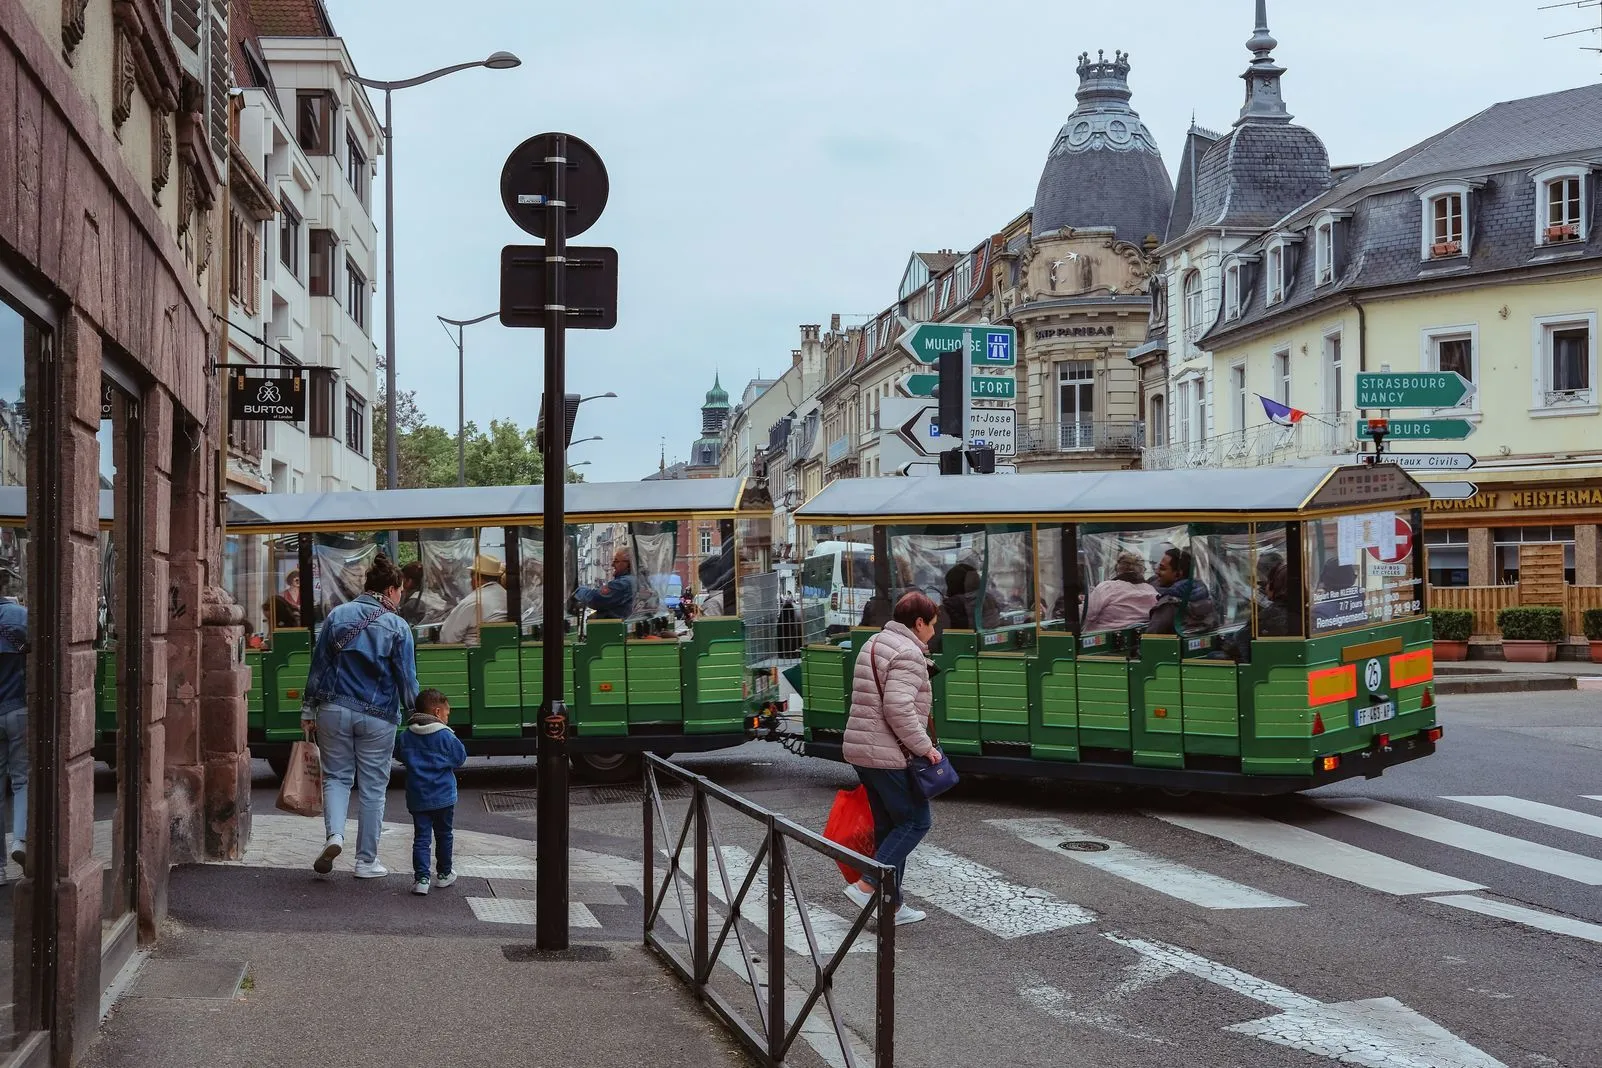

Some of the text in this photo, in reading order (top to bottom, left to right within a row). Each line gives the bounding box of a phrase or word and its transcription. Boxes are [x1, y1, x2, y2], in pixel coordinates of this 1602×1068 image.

[1057, 325, 1115, 338] PARIBAS
[925, 338, 982, 352] MULHOSE
[972, 381, 1010, 394] LFORT
[1361, 377, 1446, 389] STRASBOURG
[1361, 392, 1405, 403] NANCY
[243, 405, 294, 415] BURTON
[970, 413, 1011, 423] nt-Josse
[988, 427, 1011, 437] Verte
[1361, 424, 1431, 435] FIBURG
[1428, 455, 1459, 466] Civils
[1316, 611, 1369, 629] Renseignements
[1367, 661, 1379, 688] 25
